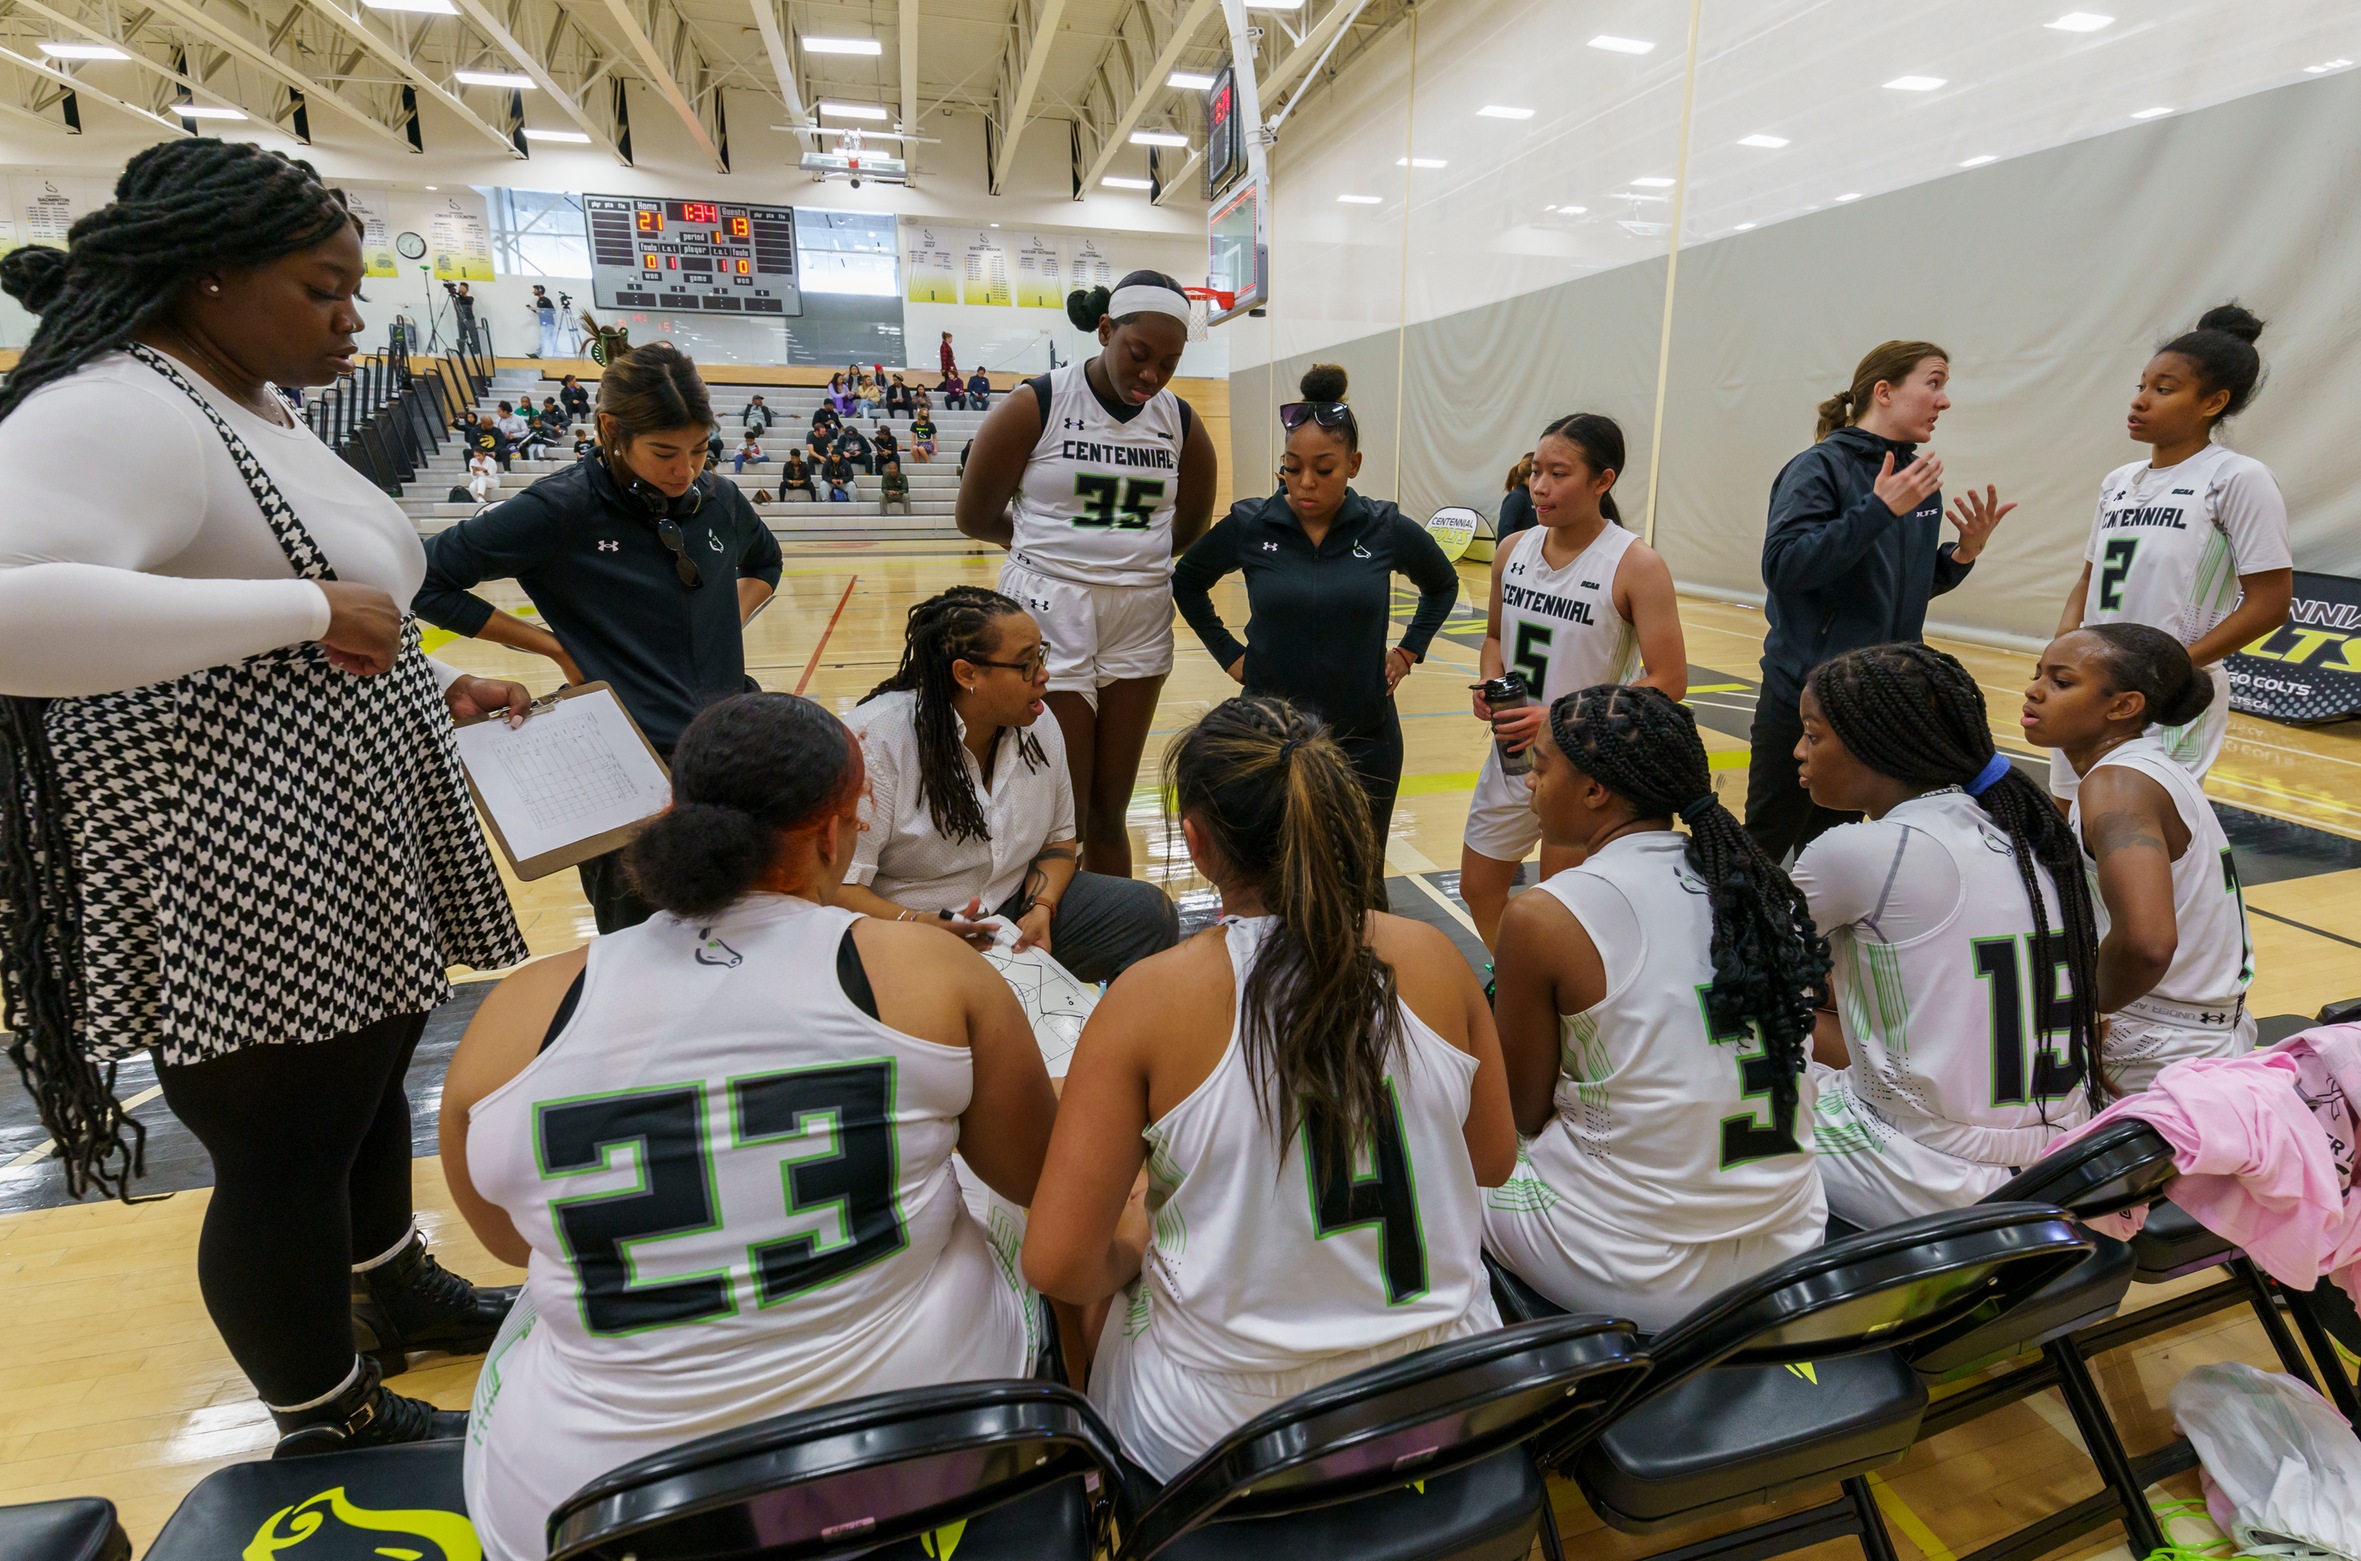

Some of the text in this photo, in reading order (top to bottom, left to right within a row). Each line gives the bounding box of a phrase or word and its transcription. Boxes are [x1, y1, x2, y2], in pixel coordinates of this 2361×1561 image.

[637, 201, 658, 211] Home
[683, 203, 717, 223] 1:34
[721, 207, 746, 217] Guests
[639, 211, 664, 231] 21
[732, 217, 749, 237] 13
[683, 232, 705, 242] period
[715, 231, 721, 244] 1
[640, 242, 658, 252] fouls
[683, 245, 707, 255] player
[732, 248, 749, 257] fouls
[646, 254, 657, 269] 0
[670, 256, 676, 269] 1
[722, 259, 728, 272] 1
[739, 259, 749, 274] 0
[645, 272, 659, 280] won
[689, 274, 707, 283] game
[736, 277, 750, 285] won
[1063, 440, 1174, 470] CENTENNIAL
[1071, 471, 1166, 531] 35
[1431, 517, 1474, 528] CENTENNIAL
[2098, 537, 2141, 612] 2
[1503, 583, 1595, 626] CENTENNIAL
[1512, 619, 1554, 702] 5
[2252, 676, 2312, 696] COLTS
[1970, 928, 2090, 1108] 15
[2152, 1005, 2196, 1020] UNDER
[1694, 982, 1805, 1172] 3
[531, 1055, 910, 1338] 23
[1298, 1074, 1431, 1308] 4
